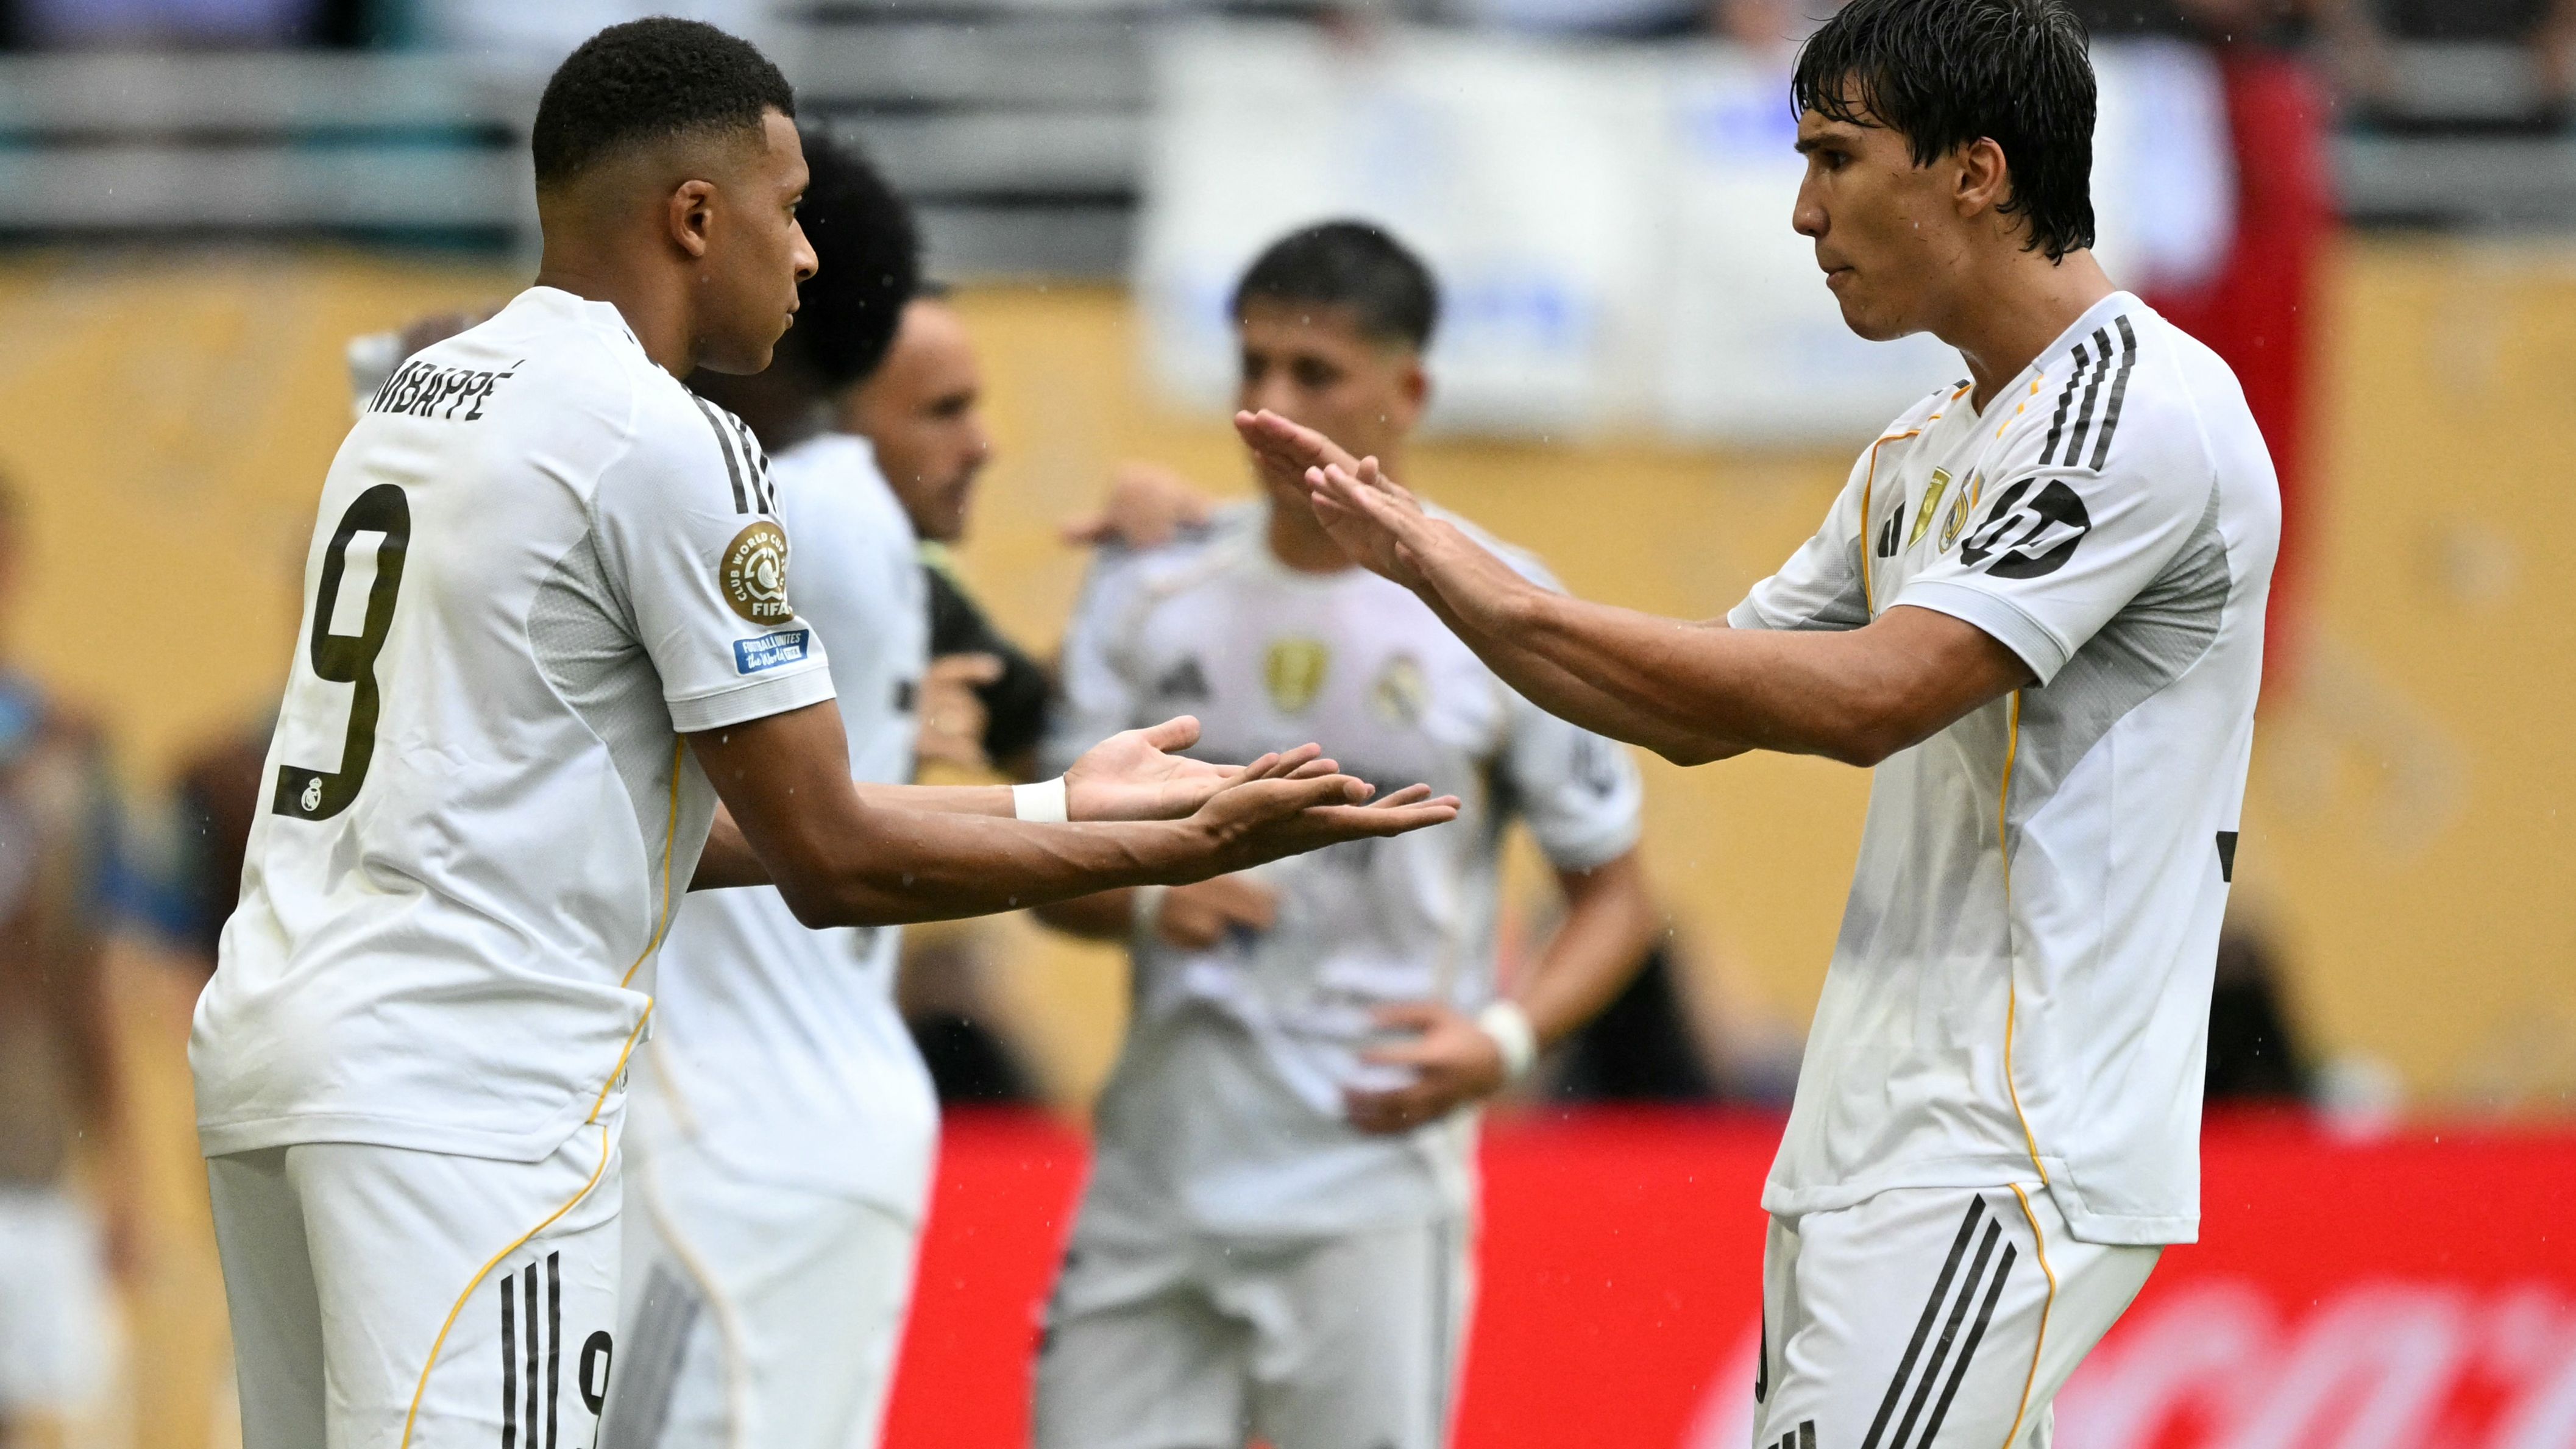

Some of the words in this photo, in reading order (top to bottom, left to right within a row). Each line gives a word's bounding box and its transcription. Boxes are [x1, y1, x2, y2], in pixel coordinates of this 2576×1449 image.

[366, 359, 526, 421] MBAPPÉ
[733, 531, 768, 565] WORLD
[770, 533, 784, 553] CUP
[730, 570, 748, 602] CLUB
[752, 600, 790, 617] FIFA
[272, 483, 411, 821] 9
[774, 632, 801, 647] UNITES
[746, 653, 762, 669] the
